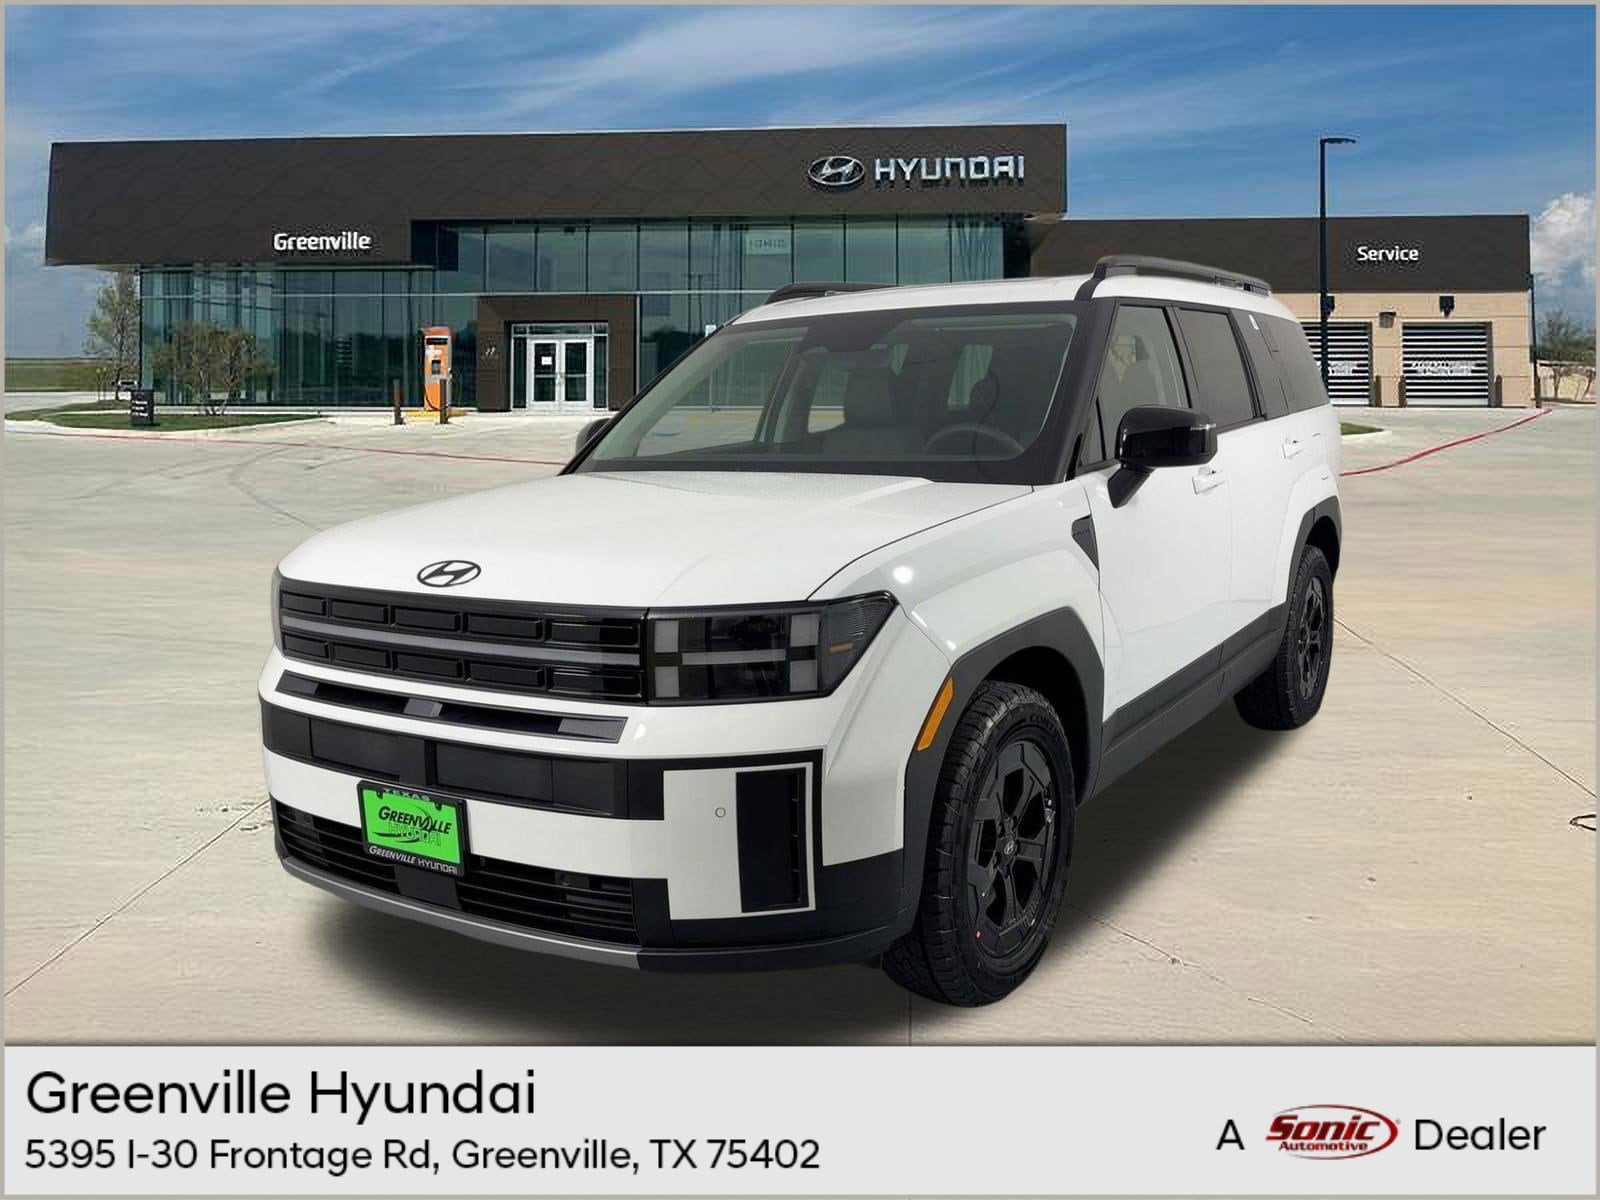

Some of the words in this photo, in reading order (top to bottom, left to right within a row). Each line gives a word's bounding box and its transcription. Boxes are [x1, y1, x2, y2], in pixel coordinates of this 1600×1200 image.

[874, 154, 1025, 182] HYUNDAI
[273, 230, 372, 252] Greenville
[1356, 245, 1419, 262] Service
[383, 788, 431, 802] TEXAS
[378, 806, 452, 835] GREENVILLE
[387, 822, 442, 847] HYUNDAI
[369, 845, 416, 864] GREENVILLE
[417, 857, 458, 875] HYUNDAI
